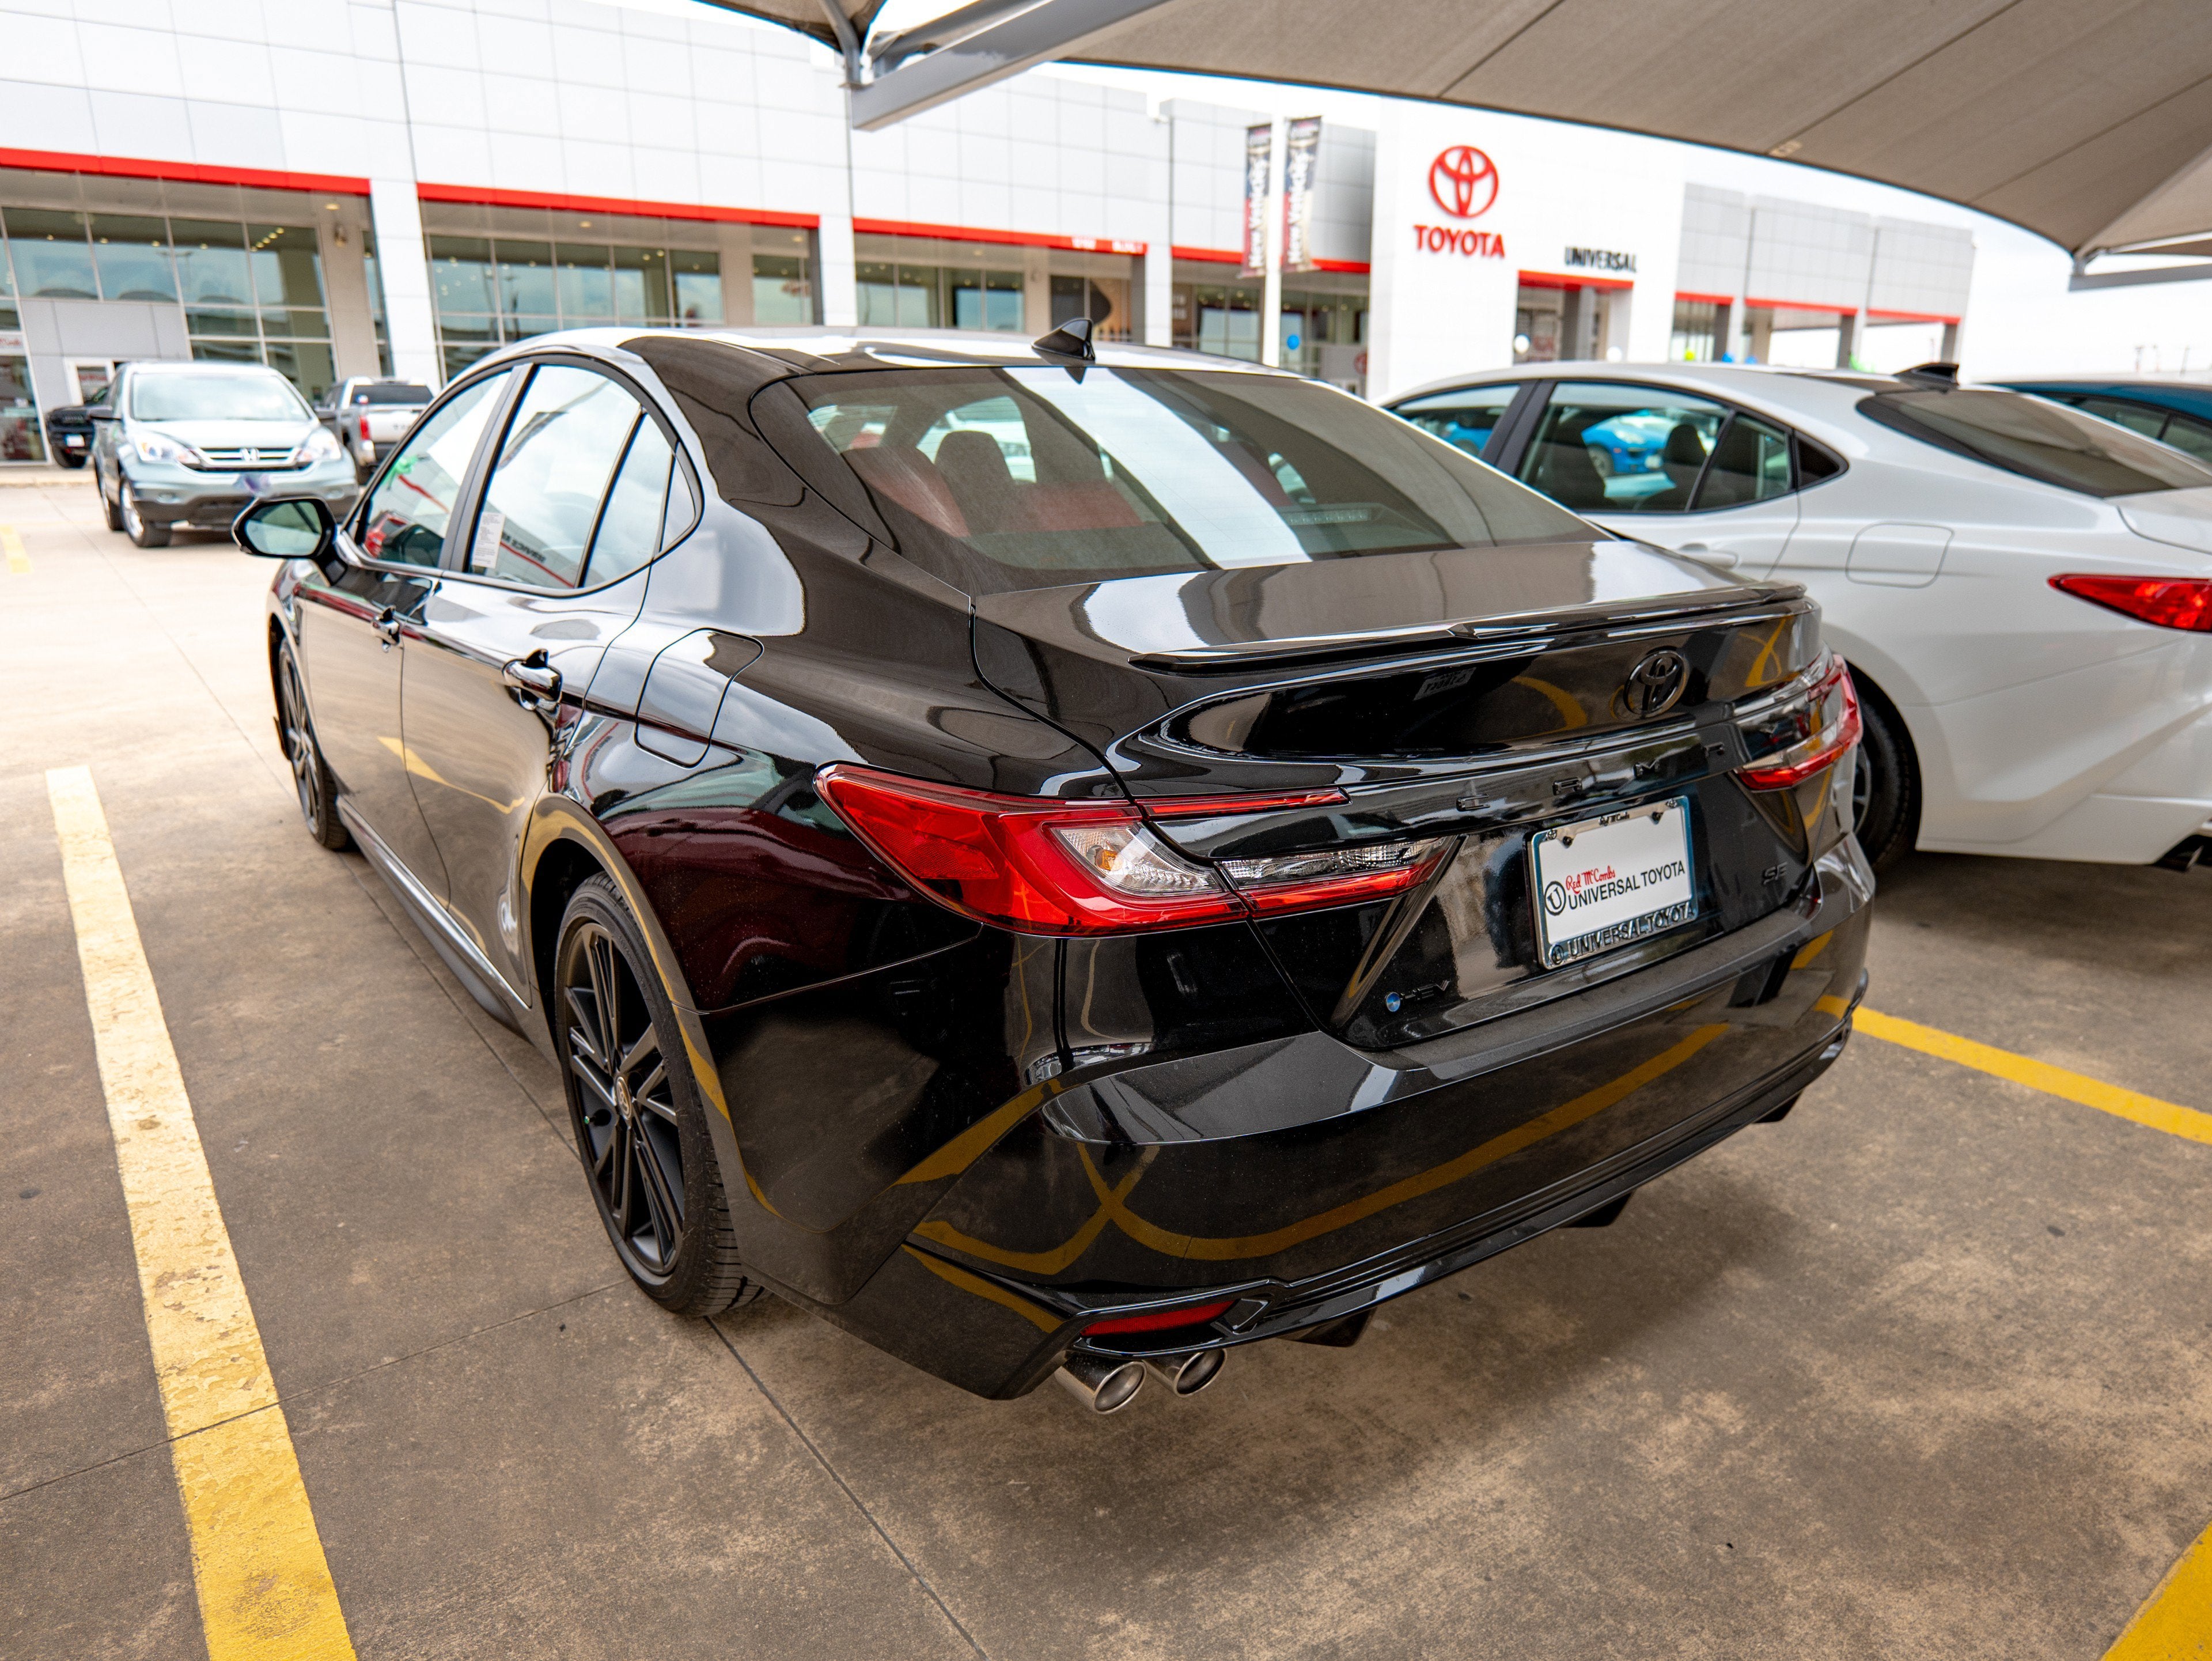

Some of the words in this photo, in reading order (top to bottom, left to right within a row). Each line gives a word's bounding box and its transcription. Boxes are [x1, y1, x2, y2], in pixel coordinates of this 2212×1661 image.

[1414, 224, 1505, 258] TOYOTA
[1565, 246, 1637, 273] UNIVERSAL
[1565, 874, 1582, 894] Red
[1567, 875, 1641, 910] UNIVERSAL
[1641, 860, 1685, 887] TOYOTA
[1762, 862, 1787, 886] SE
[1567, 918, 1646, 958] UNIVERSAL
[1646, 902, 1695, 932] TOYOTA
